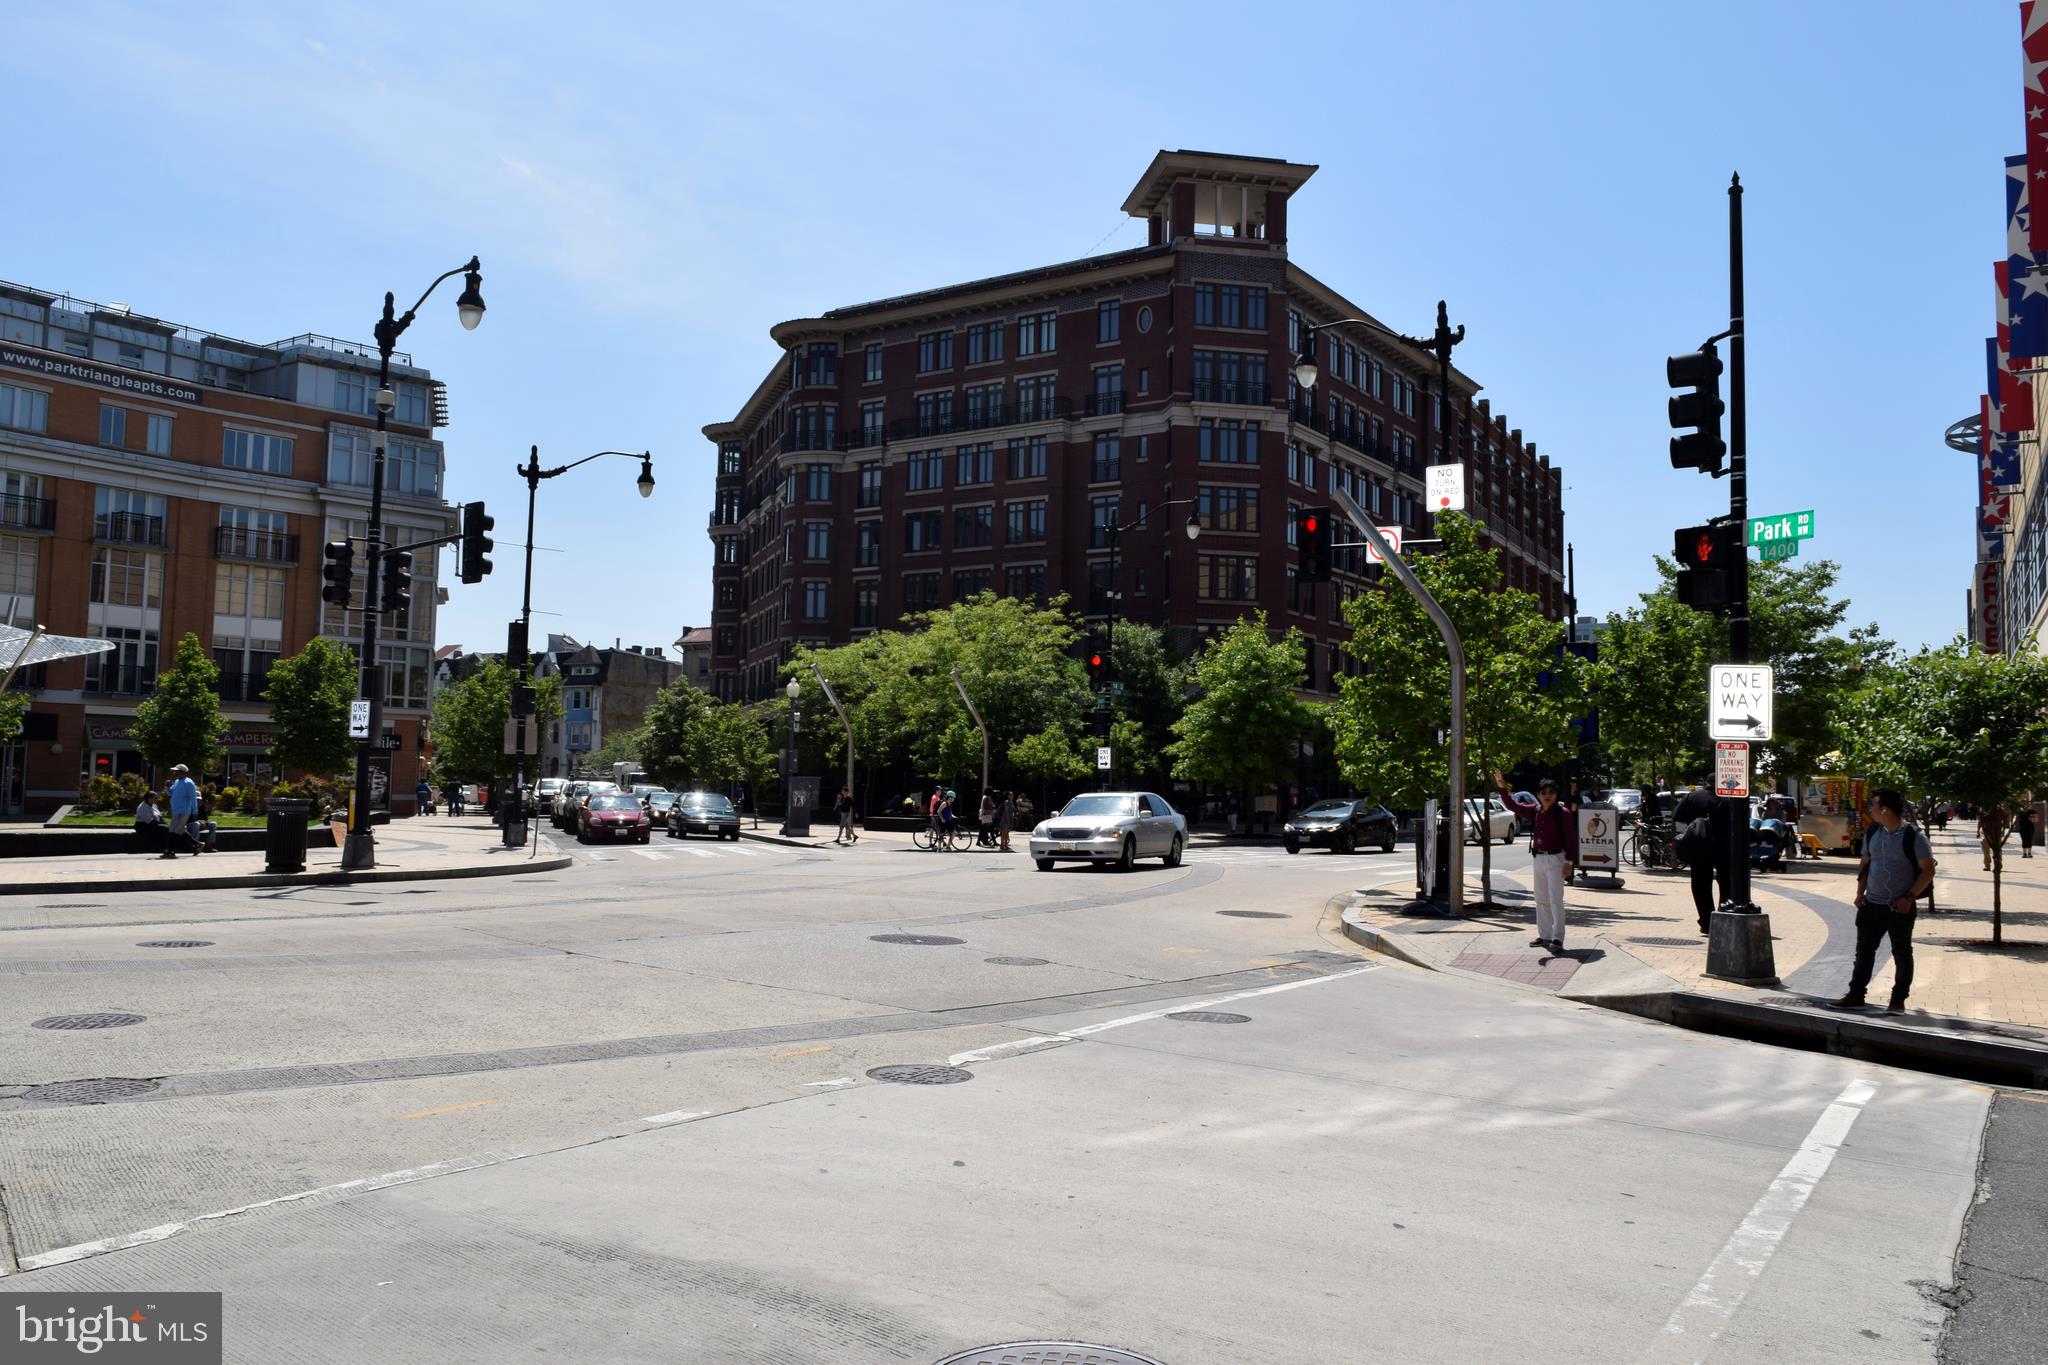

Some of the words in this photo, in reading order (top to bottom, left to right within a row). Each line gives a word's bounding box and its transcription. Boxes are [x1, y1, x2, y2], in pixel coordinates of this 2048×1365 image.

[3, 352, 196, 401] www.parktriangleapts.com
[1437, 468, 1453, 477] NO
[1430, 488, 1441, 496] ON
[1444, 487, 1460, 495] RED
[1754, 517, 1792, 542] Park
[1797, 514, 1809, 525] RD
[1797, 525, 1809, 536] NW
[1764, 542, 1796, 559] 1400
[1721, 672, 1762, 688] ONE
[1721, 692, 1763, 709] WAY
[353, 703, 368, 713] ONE
[352, 713, 367, 723] WAY
